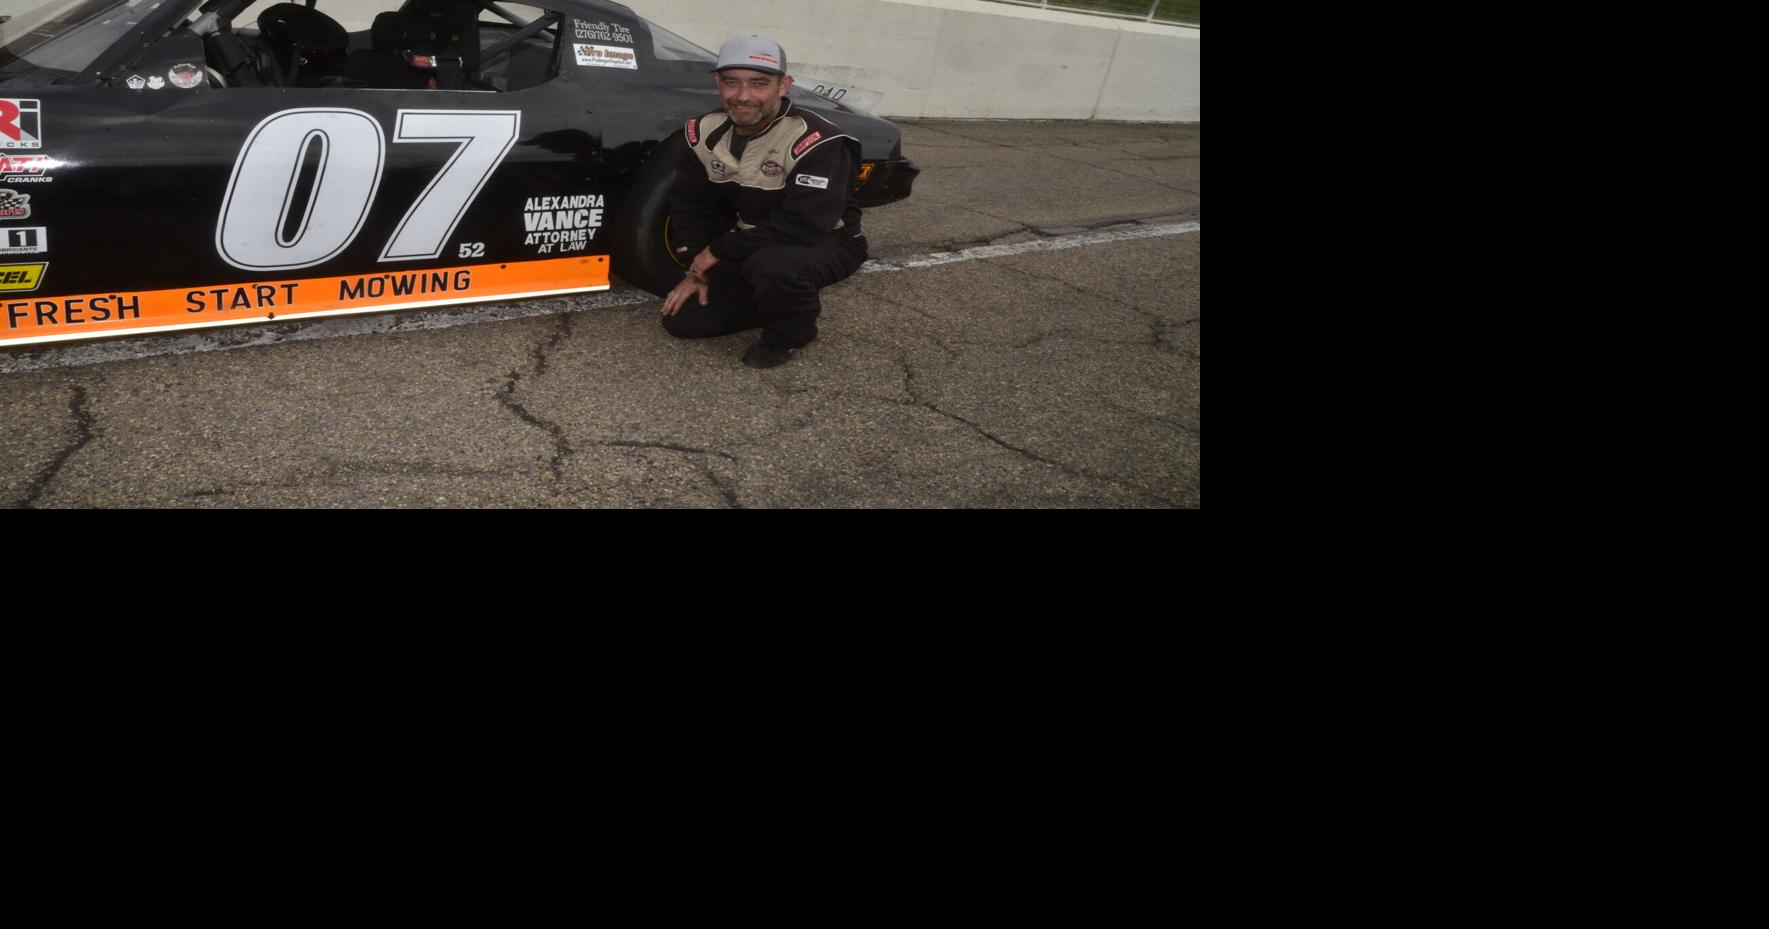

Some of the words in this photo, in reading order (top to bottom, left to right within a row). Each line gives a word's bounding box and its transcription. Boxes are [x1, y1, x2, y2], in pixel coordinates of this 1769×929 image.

[573, 19, 610, 32] Friendly
[611, 23, 630, 33] Tire
[215, 107, 521, 271] 07
[524, 194, 604, 211] ALEXANDRA
[523, 208, 604, 232] VANCE
[16, 230, 27, 246] 1
[524, 228, 597, 245] ATTORNEY
[458, 242, 485, 258] 52
[537, 243, 554, 254] AT
[559, 241, 587, 252] LAW
[7, 295, 140, 329] FRESH
[186, 283, 299, 314] START
[339, 270, 472, 301] MOWING
